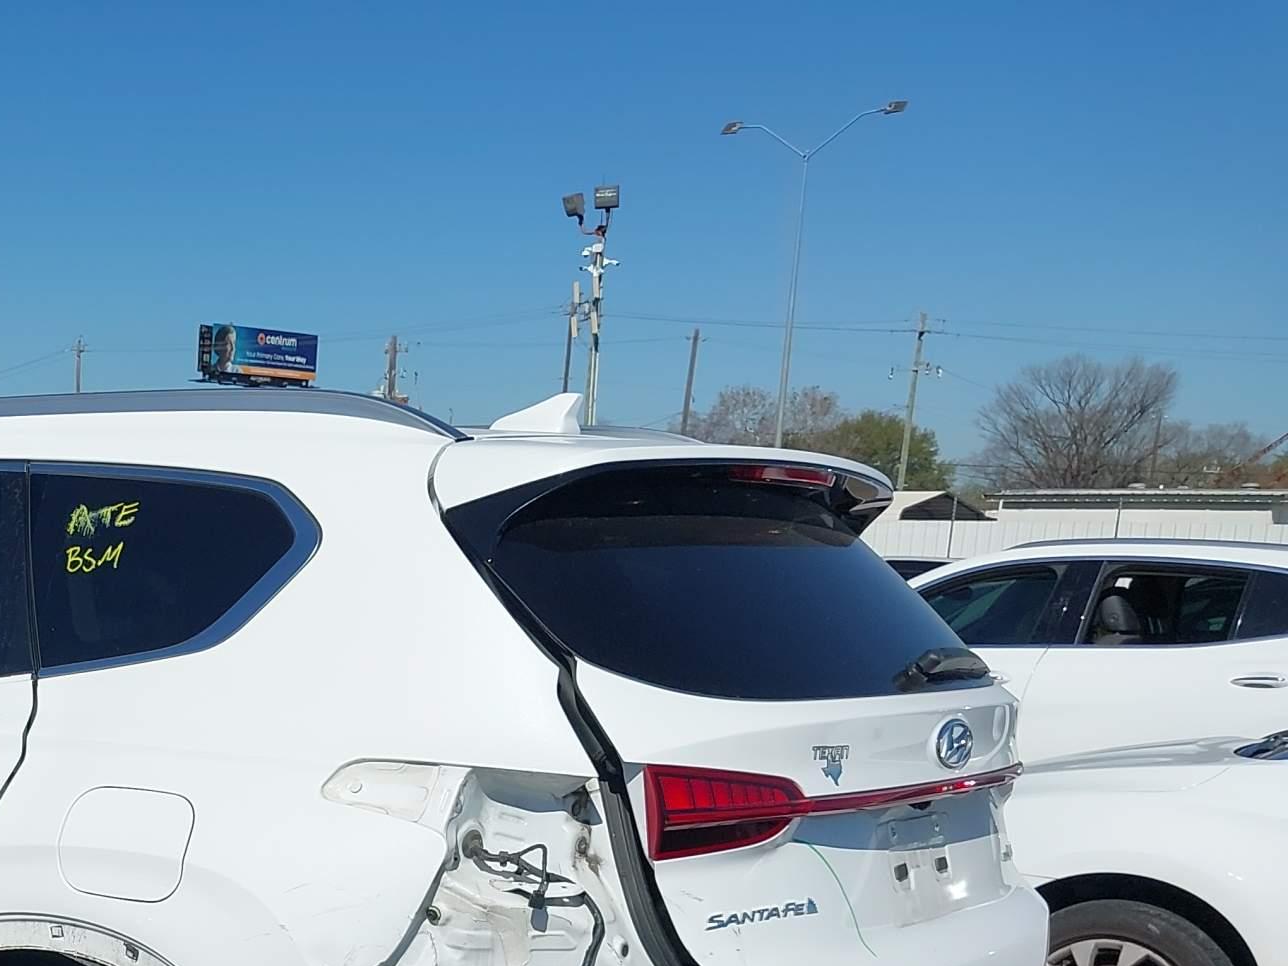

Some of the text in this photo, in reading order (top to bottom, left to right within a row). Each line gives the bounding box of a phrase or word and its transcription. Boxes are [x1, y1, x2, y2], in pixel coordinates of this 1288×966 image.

[266, 334, 298, 347] centrum
[66, 541, 124, 573] BSM
[812, 744, 850, 761] TEXAN
